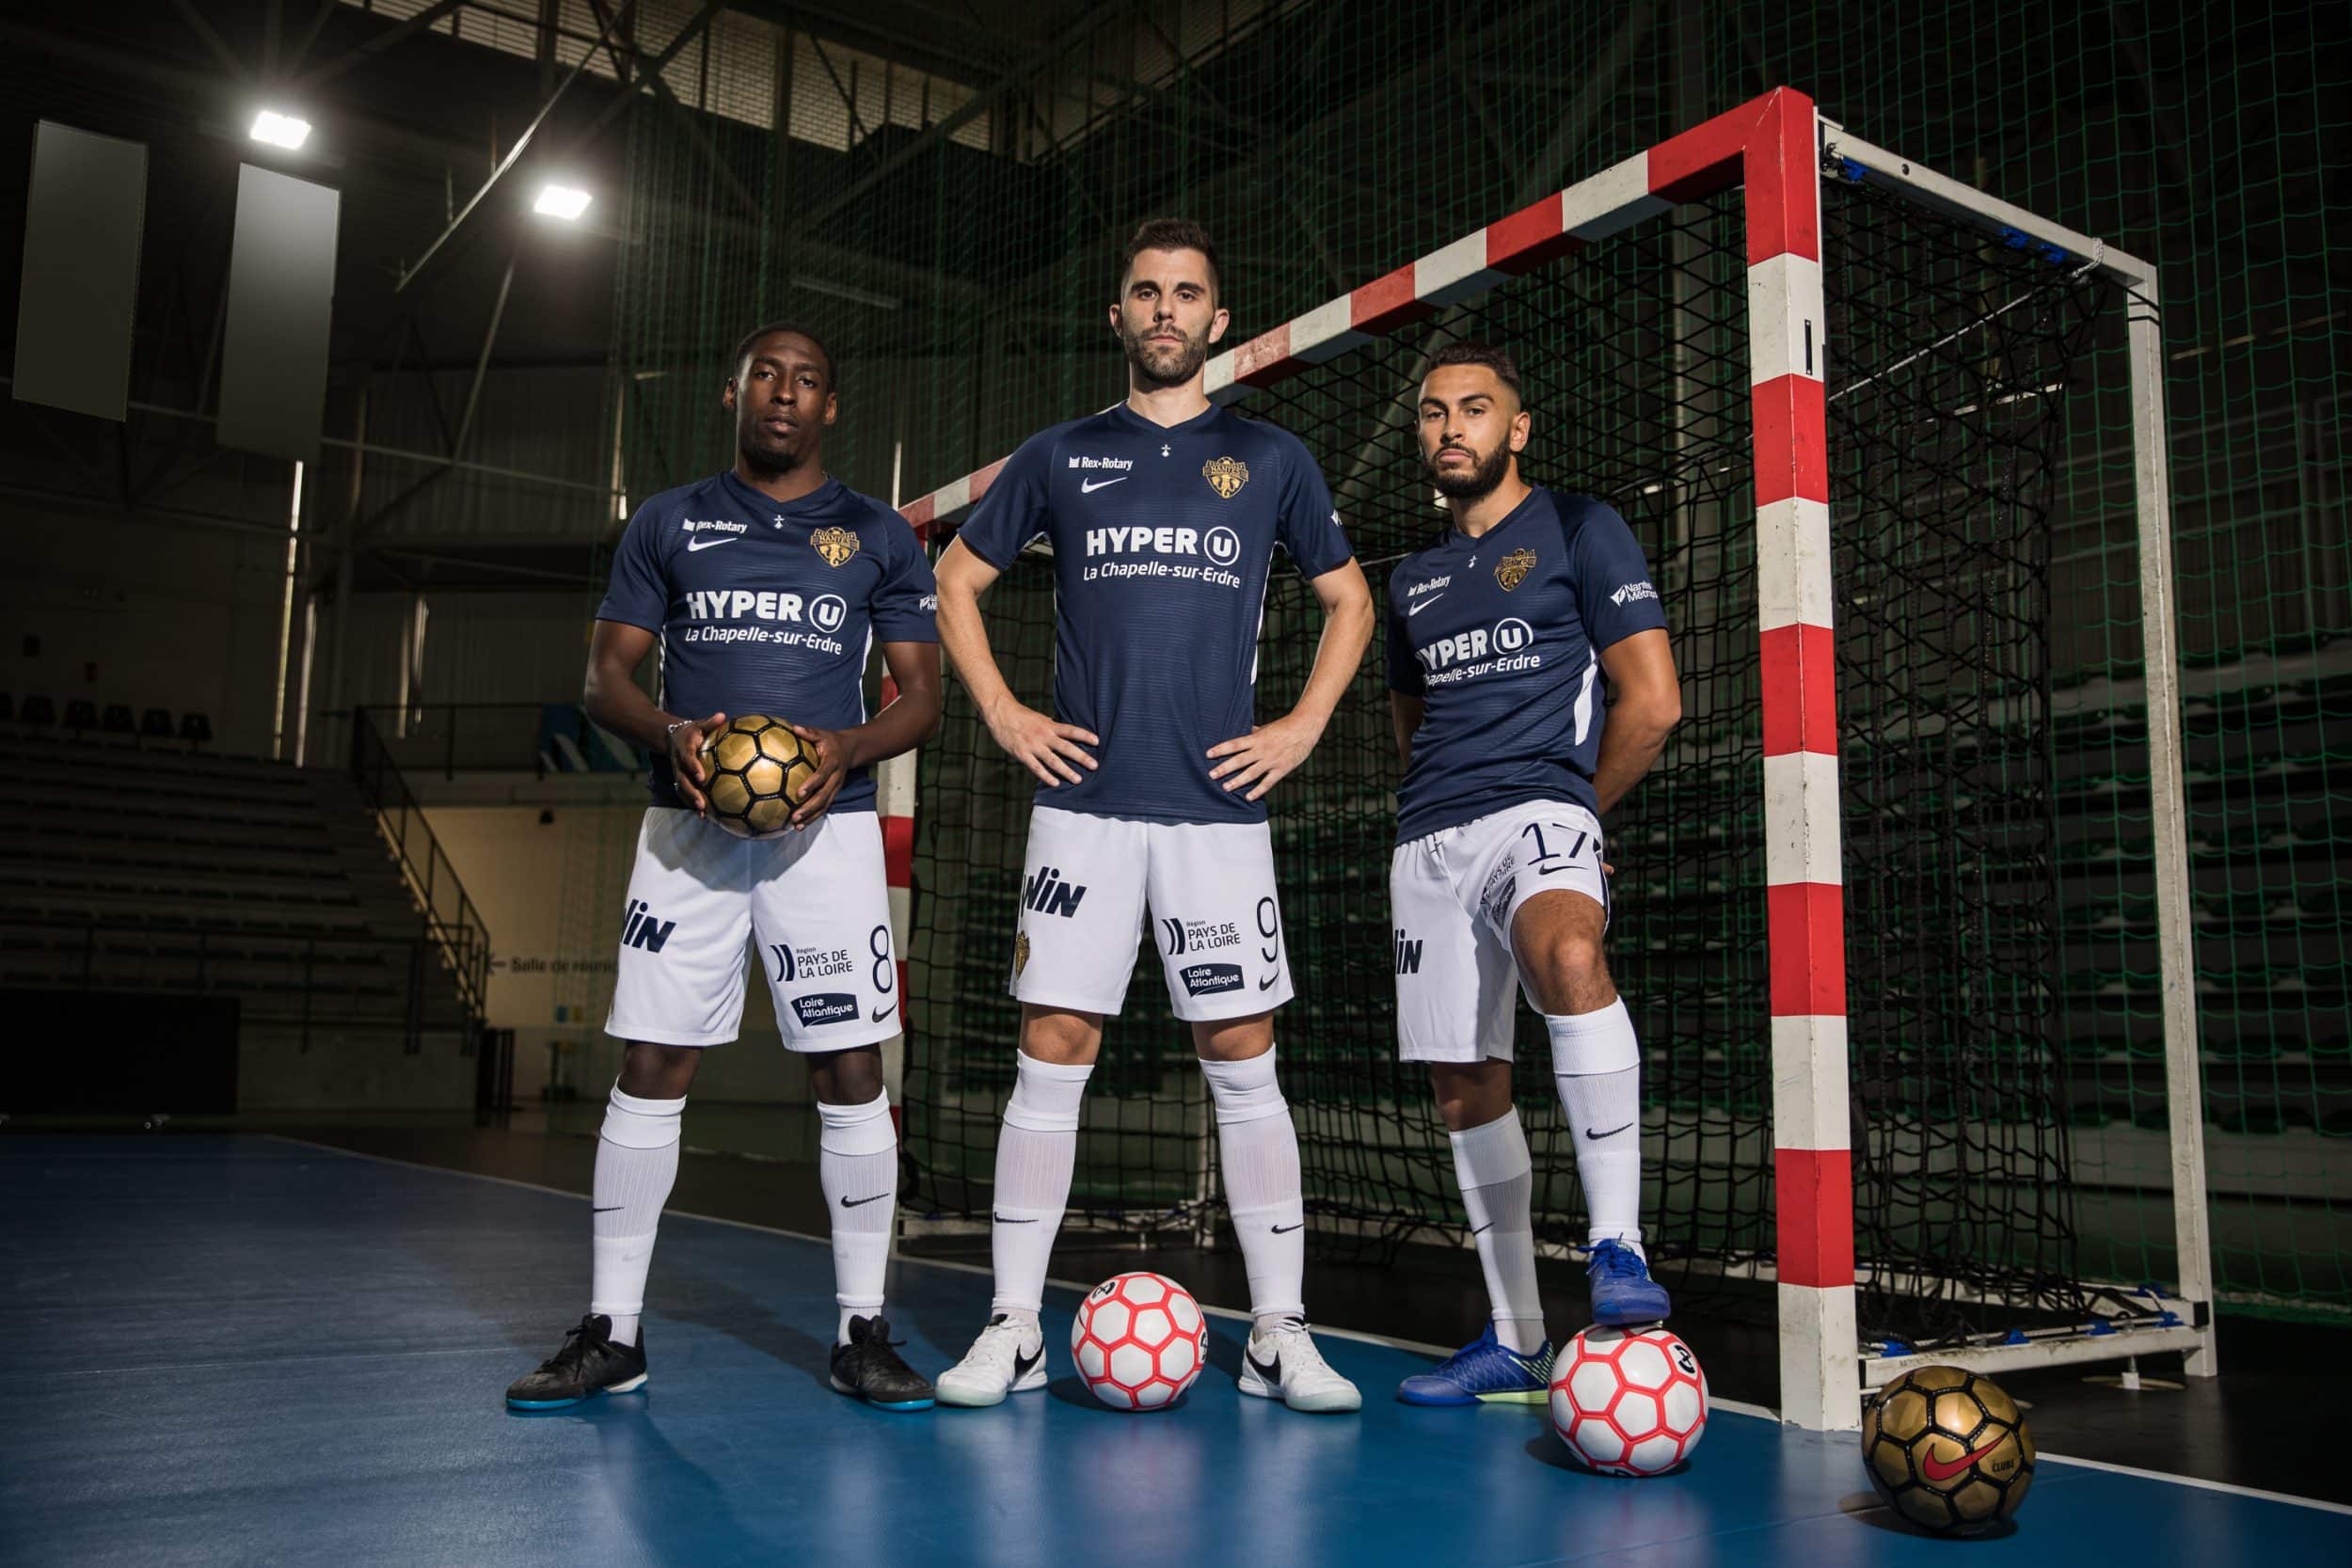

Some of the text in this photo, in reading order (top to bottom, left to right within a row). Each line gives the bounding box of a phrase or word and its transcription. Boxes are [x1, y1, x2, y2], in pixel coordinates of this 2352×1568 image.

[1087, 527, 1198, 557] HYPER
[1084, 562, 1241, 589] La Chapelle-sur-Erdre
[686, 590, 803, 622] HYPER
[685, 625, 843, 656] La Chapelle-sur-Erdre
[1522, 822, 1587, 865] 17
[1187, 922, 1236, 941] PAYS DE
[1256, 896, 1279, 963] 9
[1189, 933, 1241, 952] LA LOIRE
[798, 949, 849, 967] PAYS DE
[870, 925, 893, 994] 8
[800, 960, 853, 979] LA LOIRE
[1187, 968, 1212, 979] Loire
[1189, 974, 1241, 990] Atlantique
[800, 997, 824, 1008] Loire
[802, 1003, 854, 1019] Atlantique
